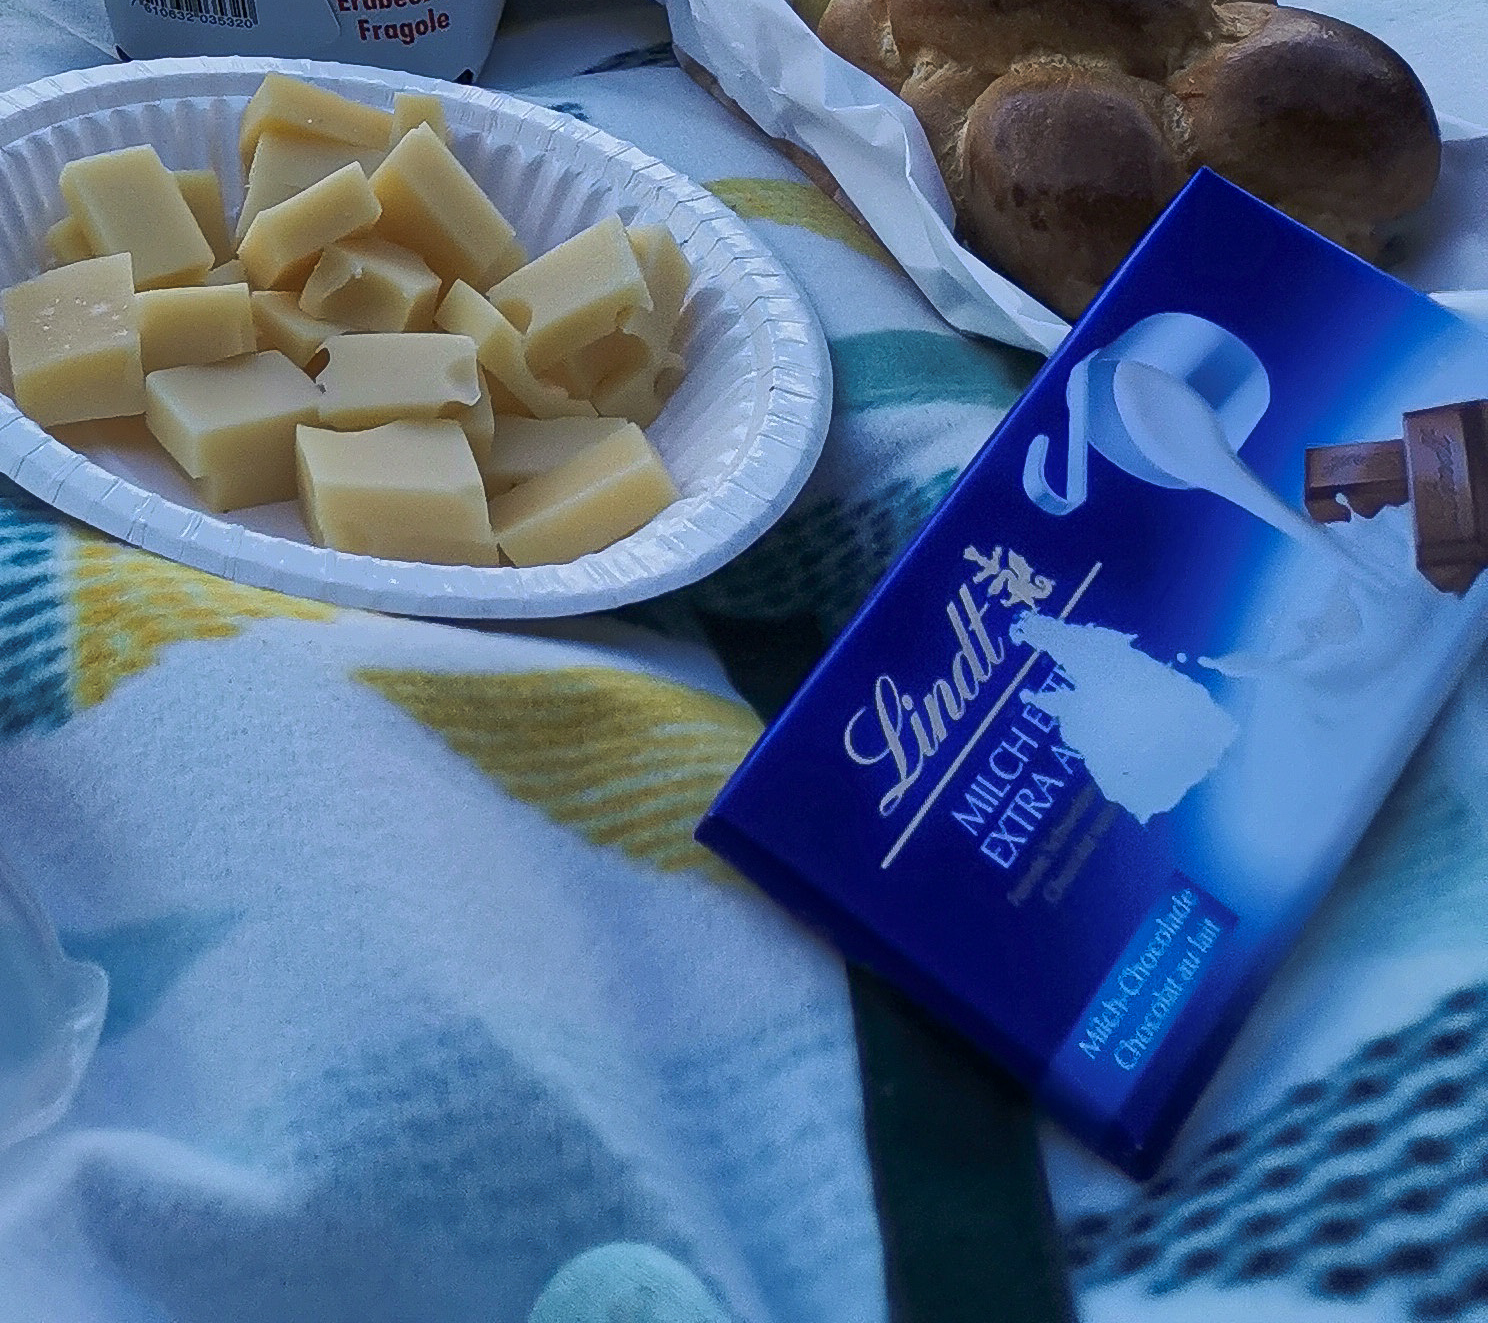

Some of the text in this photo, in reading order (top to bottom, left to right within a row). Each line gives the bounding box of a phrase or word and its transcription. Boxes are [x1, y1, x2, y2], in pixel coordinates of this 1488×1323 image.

[199, 15, 253, 29] 035320
[357, 8, 451, 46] Fragole
[844, 582, 1005, 818] Lindt
[950, 726, 1039, 837] MILCH
[979, 771, 1065, 869] EXTRA
[1078, 888, 1194, 1060] Milch-Chocolade
[1113, 917, 1223, 1071] Chocolat au lait
